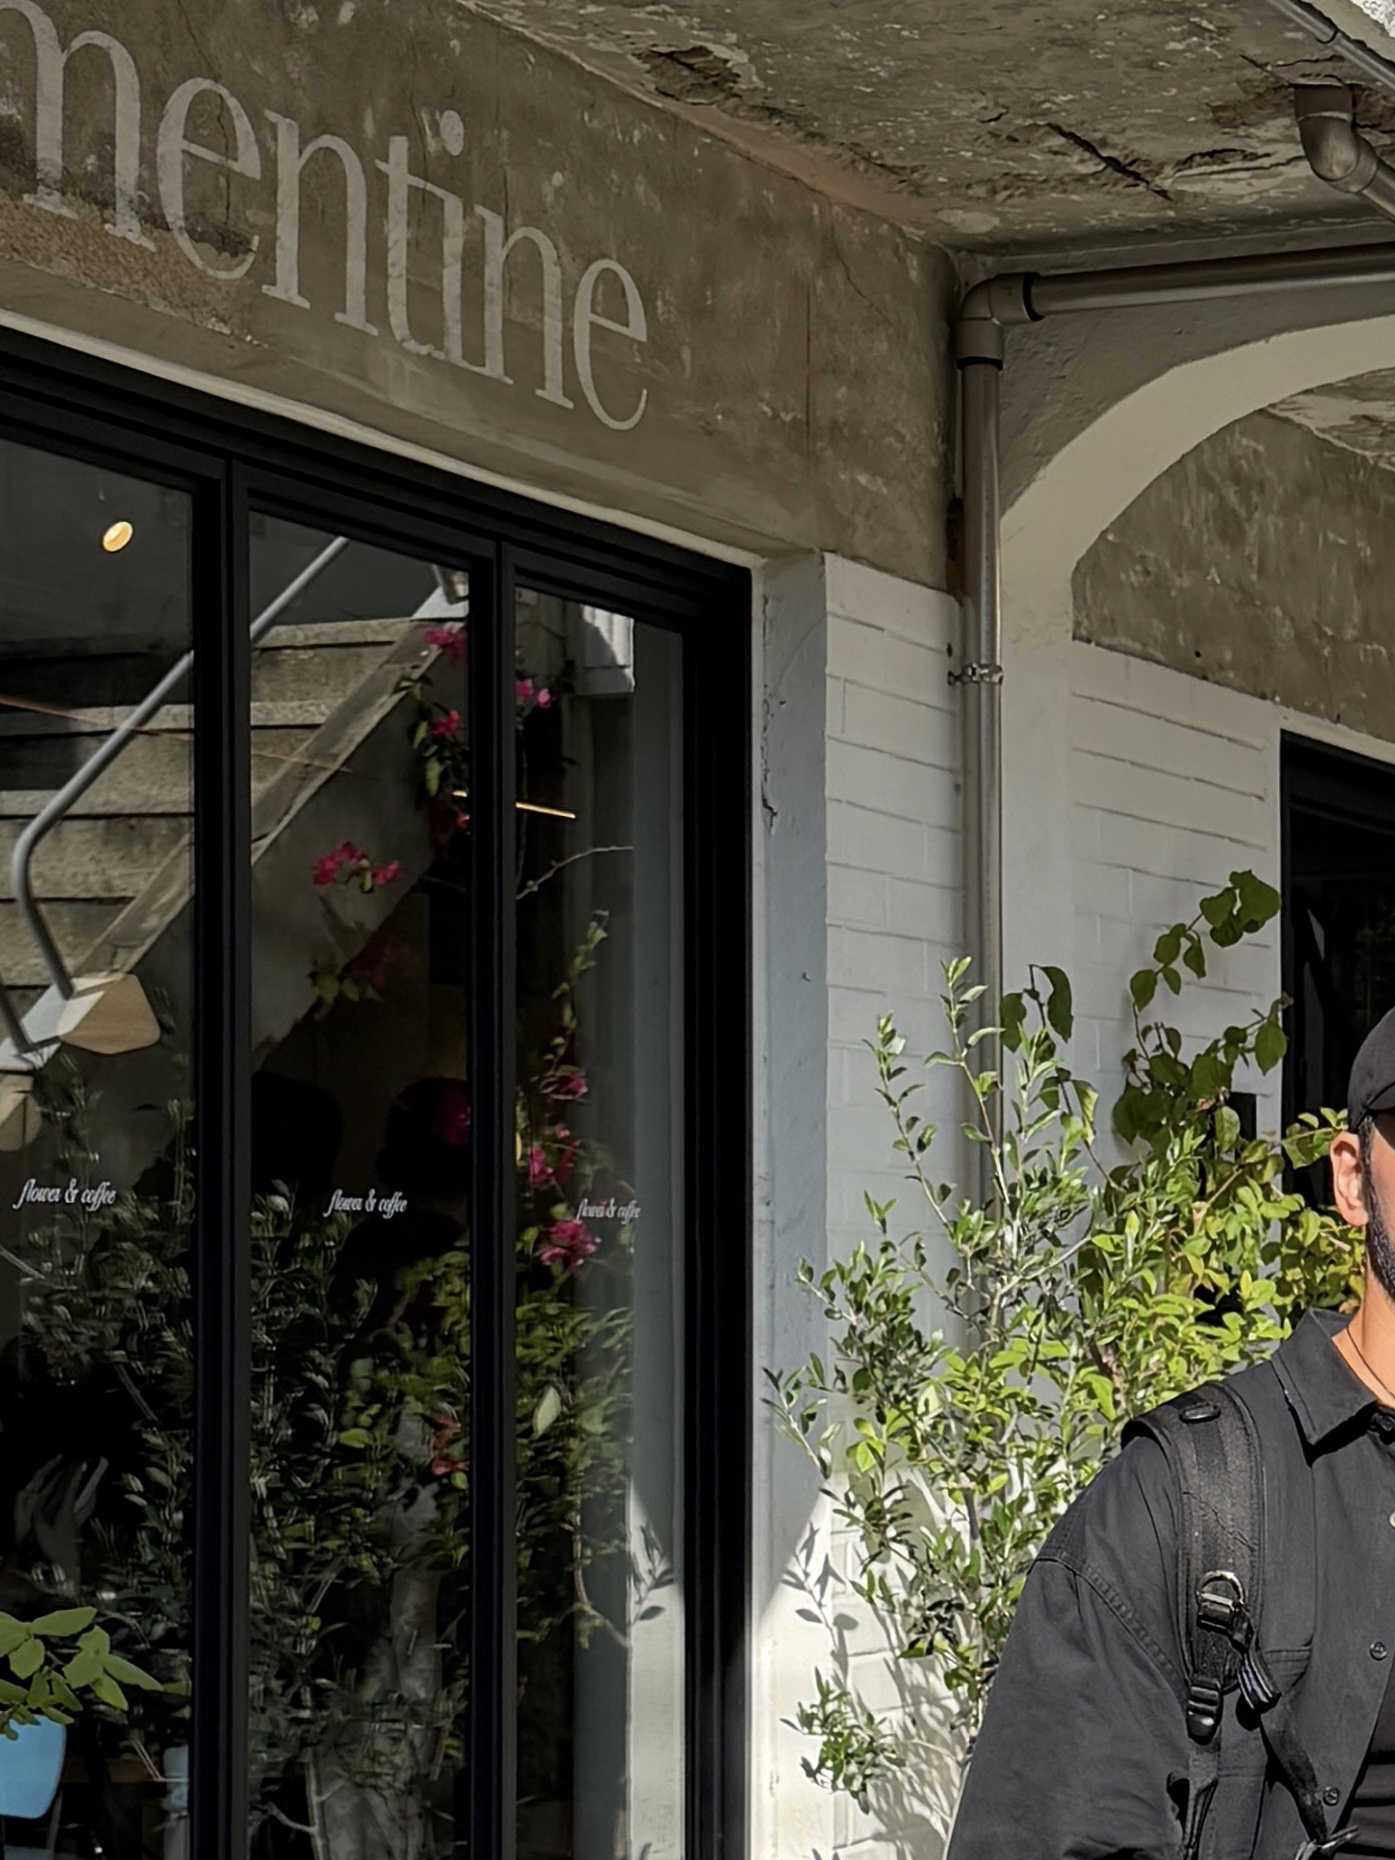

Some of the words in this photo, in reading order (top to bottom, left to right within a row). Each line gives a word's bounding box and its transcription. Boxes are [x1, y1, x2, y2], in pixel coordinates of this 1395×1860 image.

[12, 1178, 61, 1210] flower
[64, 1177, 79, 1203] &
[81, 1181, 117, 1212] coffee
[322, 1189, 363, 1217] flower
[365, 1188, 377, 1212] &
[378, 1191, 408, 1219] coffee
[606, 1197, 617, 1218] &
